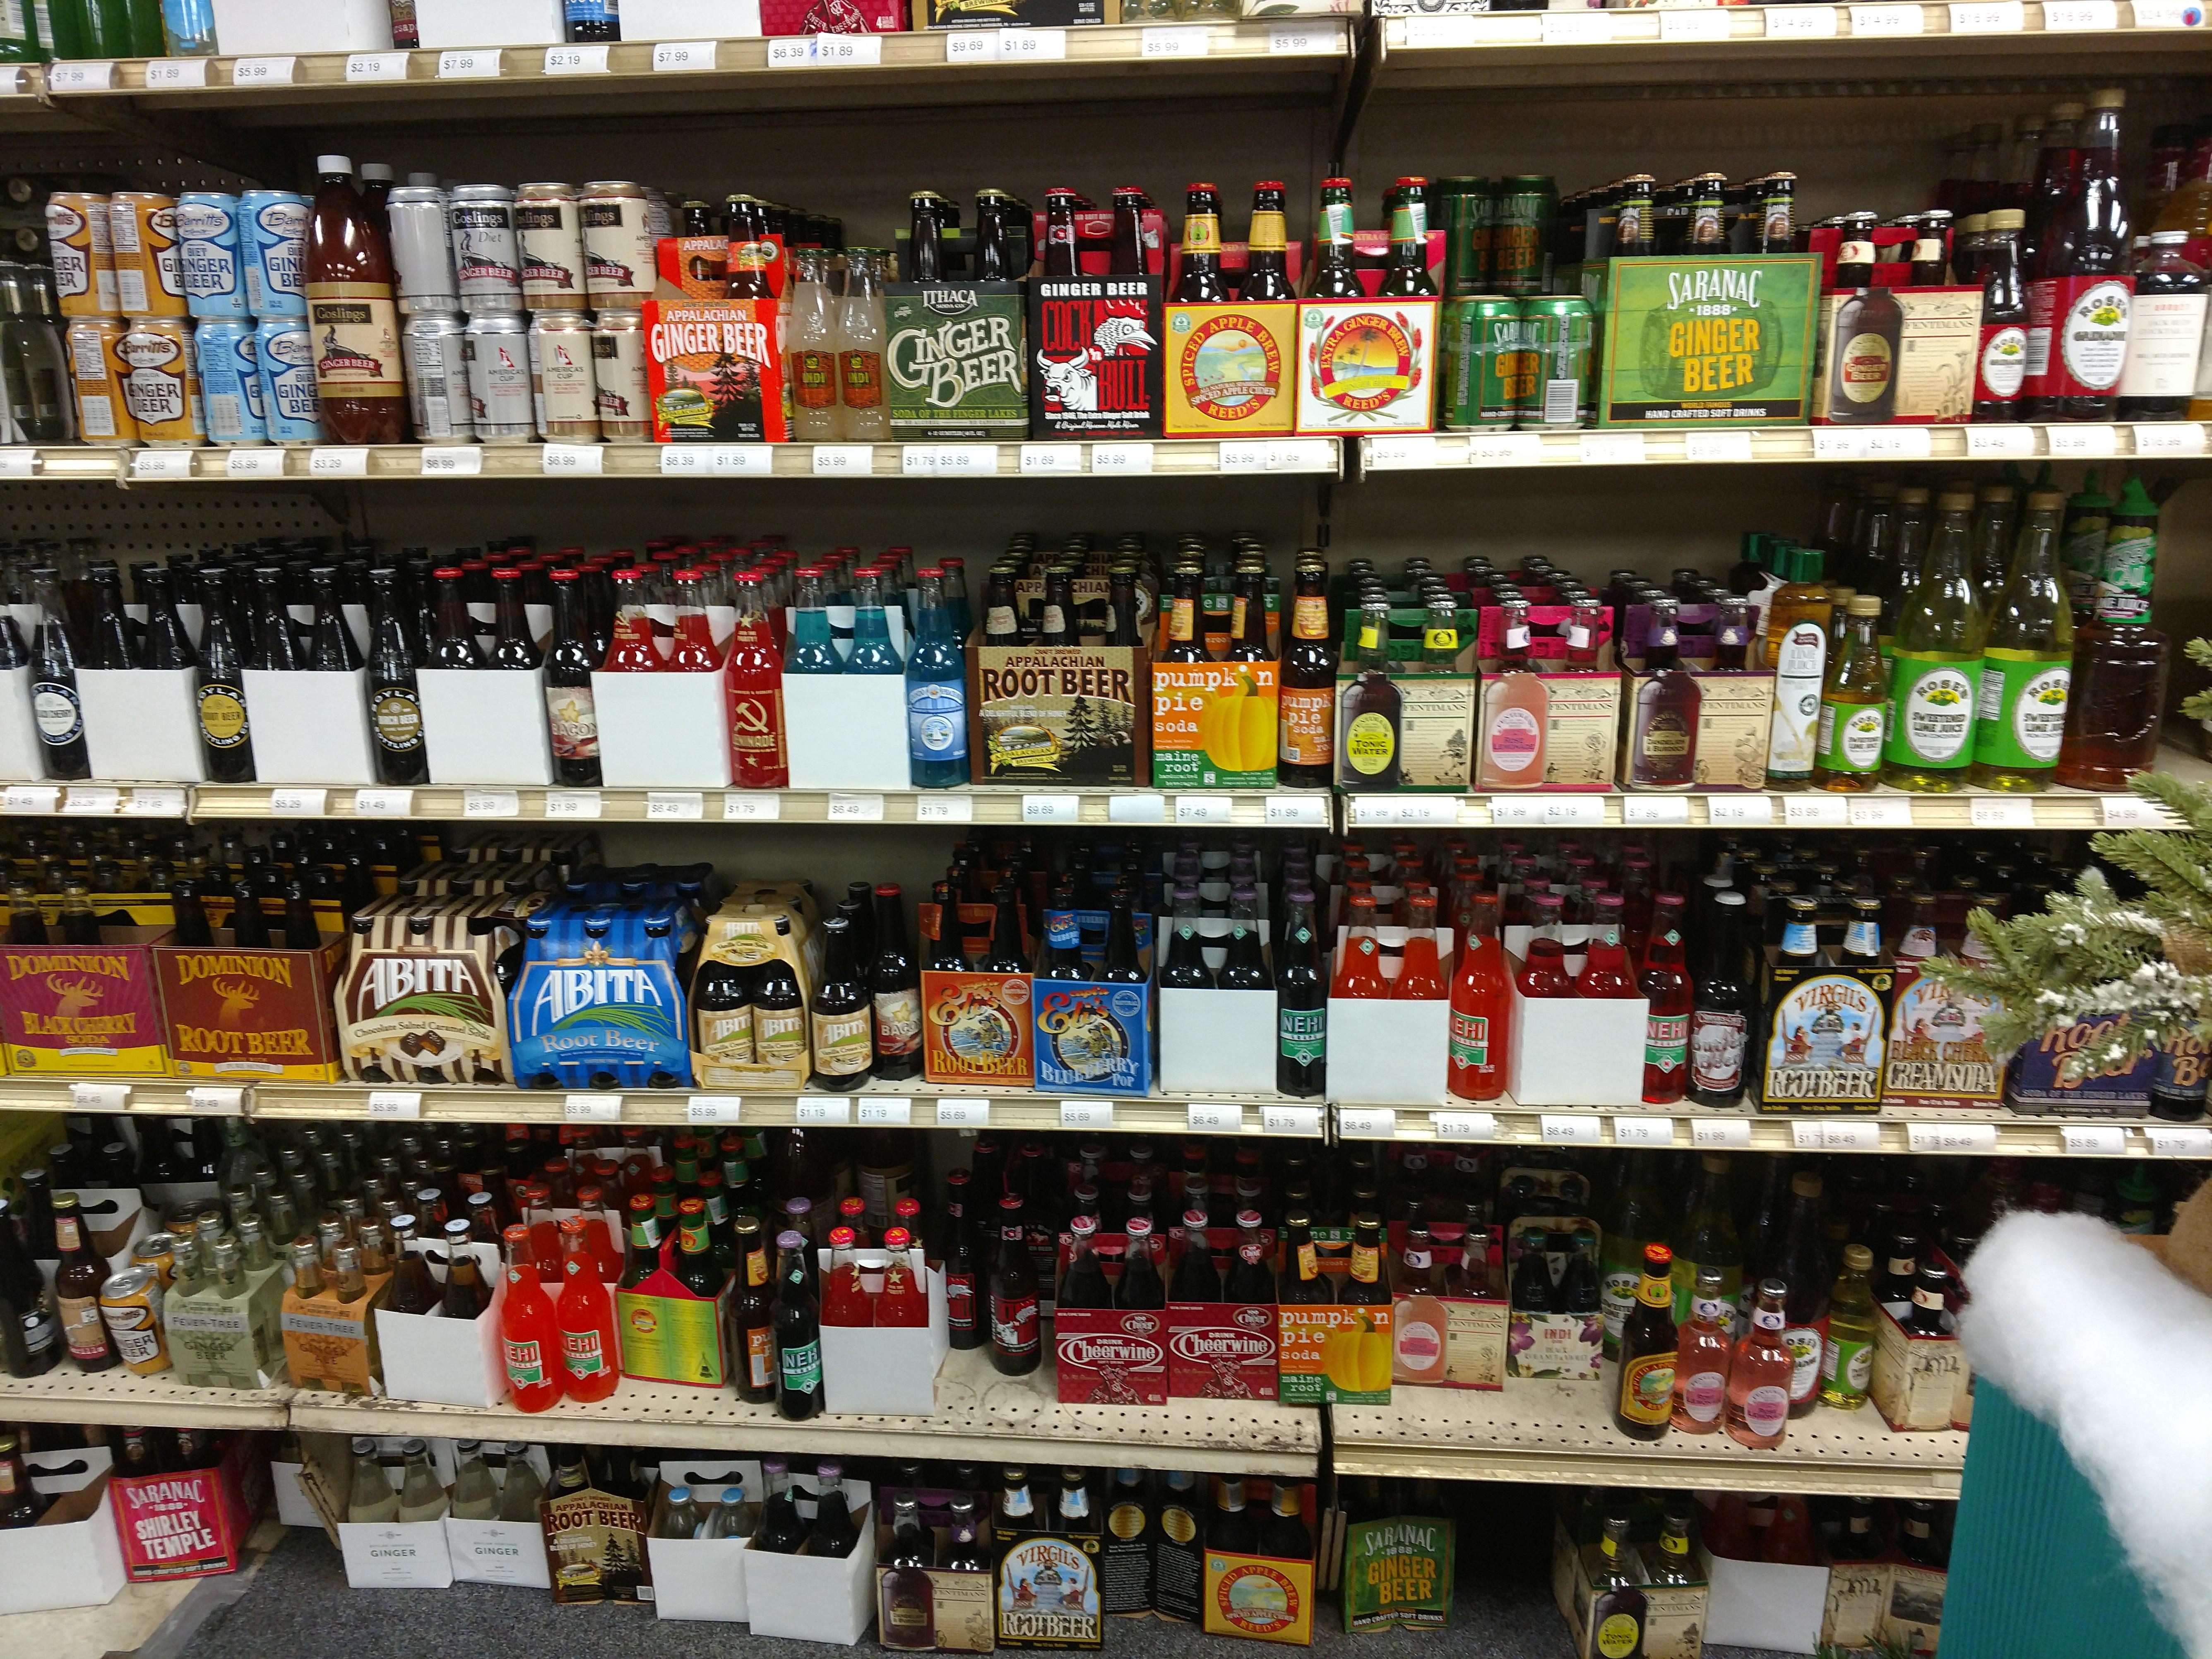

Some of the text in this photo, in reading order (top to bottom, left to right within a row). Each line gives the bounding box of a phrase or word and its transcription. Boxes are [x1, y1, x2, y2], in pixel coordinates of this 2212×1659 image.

[952, 41, 983, 52] $9.69
[1004, 40, 1036, 51] $1.89
[1274, 38, 1307, 48] $5.99
[658, 52, 688, 62] $7.99
[773, 48, 803, 59] $6.39
[822, 46, 853, 57] $1.89
[444, 59, 473, 70] $7.99
[550, 56, 580, 66] $2.19
[238, 67, 267, 77] $5.99
[351, 63, 380, 72] $2.19
[55, 72, 84, 82] $7.99
[150, 69, 180, 79] $1.89
[453, 211, 503, 226] Goslings
[478, 231, 502, 243] Diet
[459, 267, 513, 280] GINGER BEER
[1041, 282, 1148, 296] GINGER BEER
[1667, 269, 1763, 310] SARANAC
[922, 290, 979, 308] ITHACA
[316, 307, 366, 322] Goslings
[1697, 304, 1731, 315] 1888
[666, 310, 747, 322] APPALACHIAN
[1042, 300, 1092, 351] COCK
[1321, 316, 1388, 369] EXTRA GINGER
[1669, 319, 1761, 357] GINGER
[651, 322, 771, 369] GINGER BEER
[887, 317, 1017, 388] GINGER
[1184, 317, 1280, 386] SPICED APPLE BREW
[321, 359, 375, 369] GINGER BEER
[1684, 353, 1753, 392] BEER
[925, 350, 1022, 407] BEER
[1098, 360, 1150, 411] BULL
[1222, 386, 1276, 399] APPLE CIDER
[1343, 391, 1391, 409] REED'S
[892, 409, 916, 418] SODA
[918, 409, 930, 418] OF
[988, 409, 1017, 418] LAKES
[1208, 399, 1260, 419] REED'S
[1671, 409, 1709, 417] CRAFTED
[1733, 408, 1766, 416] DRINKS
[314, 459, 342, 468] $3.29
[547, 456, 576, 466] $6.99
[665, 456, 695, 466] $6.39
[716, 456, 746, 466] $1.89
[817, 457, 846, 466] $5.99
[906, 457, 934, 466] $1.79
[940, 455, 969, 466] $5.89
[1025, 456, 1054, 466] $1.69
[1096, 454, 1125, 465] $5.99
[1006, 656, 1105, 667] APPALACHIAN
[981, 669, 1055, 702] ROOT
[1061, 669, 1134, 704] BEER
[1154, 692, 1203, 715] pie
[1289, 710, 1321, 725] pie
[1154, 720, 1199, 732] soda
[1293, 724, 1324, 733] soda
[1154, 751, 1199, 761] maine
[1164, 761, 1200, 772] root
[551, 803, 577, 812] $1.99
[728, 805, 755, 813] $1.79
[921, 807, 948, 815] $1.79
[1027, 805, 1054, 815] $9.69
[1179, 808, 1207, 817] $7.49
[1270, 808, 1298, 817] $1.99
[1401, 808, 1430, 817] $2.19
[1548, 807, 1577, 816] $2.19
[1714, 808, 1744, 817] $2.19
[6, 955, 130, 980] DOMINION
[175, 955, 292, 987] DOMINION
[357, 958, 479, 1022] ABITA
[531, 969, 663, 1036] ABITA
[1795, 983, 1867, 1012] VIRGIL'S
[20, 1011, 136, 1035] BLACK CHERRY
[1284, 1016, 1323, 1032] NEHI
[354, 1022, 466, 1038] Chocolate Salted Caramel
[176, 1024, 314, 1055] ROOT BEER
[540, 1030, 660, 1053] Root Beer
[932, 1050, 1028, 1075] ROOT BEER
[1040, 1056, 1140, 1085] BLUEBERRY
[1112, 1073, 1134, 1087] POP
[566, 1106, 591, 1114] $5.99
[692, 1108, 717, 1116] $5.99
[800, 1109, 825, 1118] $1.19
[861, 1109, 887, 1118] $1.19
[940, 1111, 966, 1120] $5.69
[1064, 1113, 1091, 1123] $5.69
[1193, 1116, 1219, 1125] $6.49
[1269, 1119, 1295, 1127] $1.79
[1344, 1121, 1372, 1130] $6.49
[1442, 1124, 1469, 1133] $1.79
[1546, 1127, 1575, 1136] $6.49
[1620, 1128, 1648, 1137] $1.79
[1697, 1132, 1725, 1140] $1.99
[172, 1317, 240, 1328] FEVER-TREE
[289, 1318, 355, 1334] FEVER-TREE
[1281, 1330, 1325, 1346] pie
[184, 1341, 235, 1351] GINGER
[299, 1343, 349, 1357] GINGER
[1179, 1334, 1268, 1356] Cheerwine
[196, 1352, 228, 1360] BEER
[1067, 1340, 1156, 1363] Cheerwine
[1281, 1350, 1320, 1360] soda
[1282, 1375, 1322, 1384] maine
[126, 1480, 205, 1509] SARANAC
[556, 1502, 628, 1512] APPALACHIAN
[135, 1510, 201, 1540] SHIRLEY
[544, 1510, 644, 1534] ROOT BEER
[142, 1528, 216, 1560] TEMPLE
[1365, 1524, 1436, 1556] SARANAC
[475, 1547, 519, 1556] GINGER
[1017, 1546, 1080, 1570] VIRGIL'S
[1241, 1566, 1279, 1579] APPLE
[1367, 1556, 1437, 1585] GINGER
[1379, 1581, 1433, 1605] BEER
[1239, 1619, 1282, 1632] REED'S
